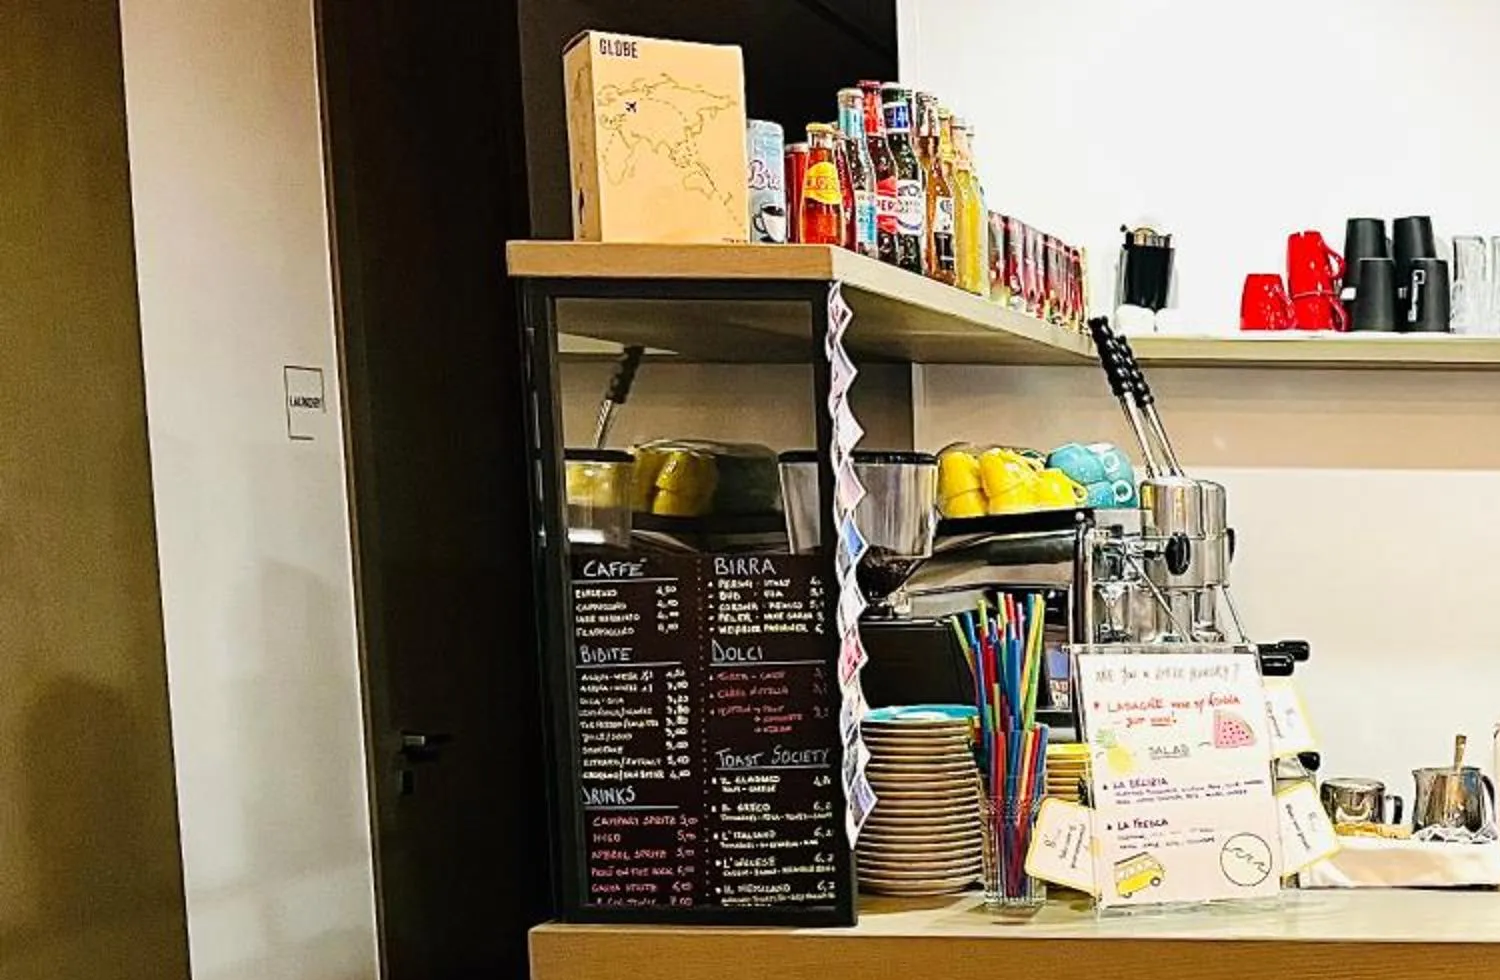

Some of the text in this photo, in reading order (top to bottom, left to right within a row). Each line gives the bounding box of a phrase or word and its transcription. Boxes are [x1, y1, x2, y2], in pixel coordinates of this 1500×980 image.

[599, 38, 638, 58] GLOBE
[714, 557, 777, 575] BIRRA
[711, 638, 763, 661] DOLCI
[715, 744, 829, 767] TOAST SOCIETY
[581, 785, 636, 804] DRINKS
